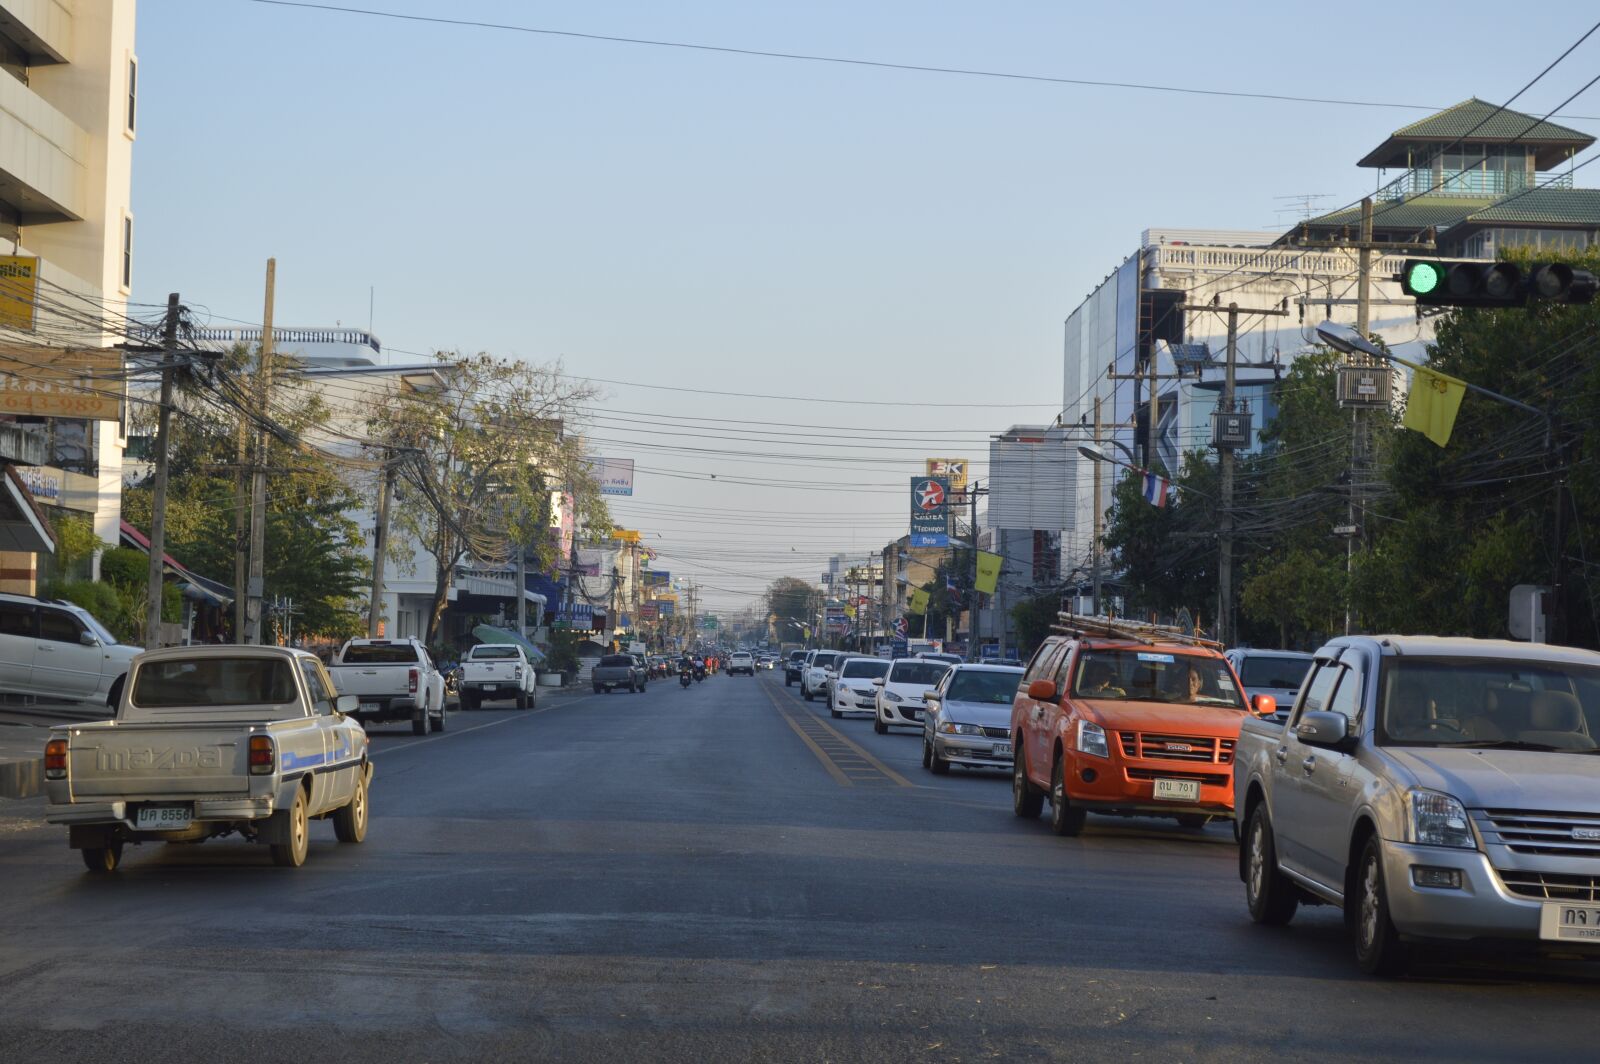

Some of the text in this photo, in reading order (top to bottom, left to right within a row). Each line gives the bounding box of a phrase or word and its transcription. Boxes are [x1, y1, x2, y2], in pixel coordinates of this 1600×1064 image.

[1178, 783, 1194, 792] 701
[161, 810, 190, 821] 8556
[1565, 908, 1587, 925] กจ
